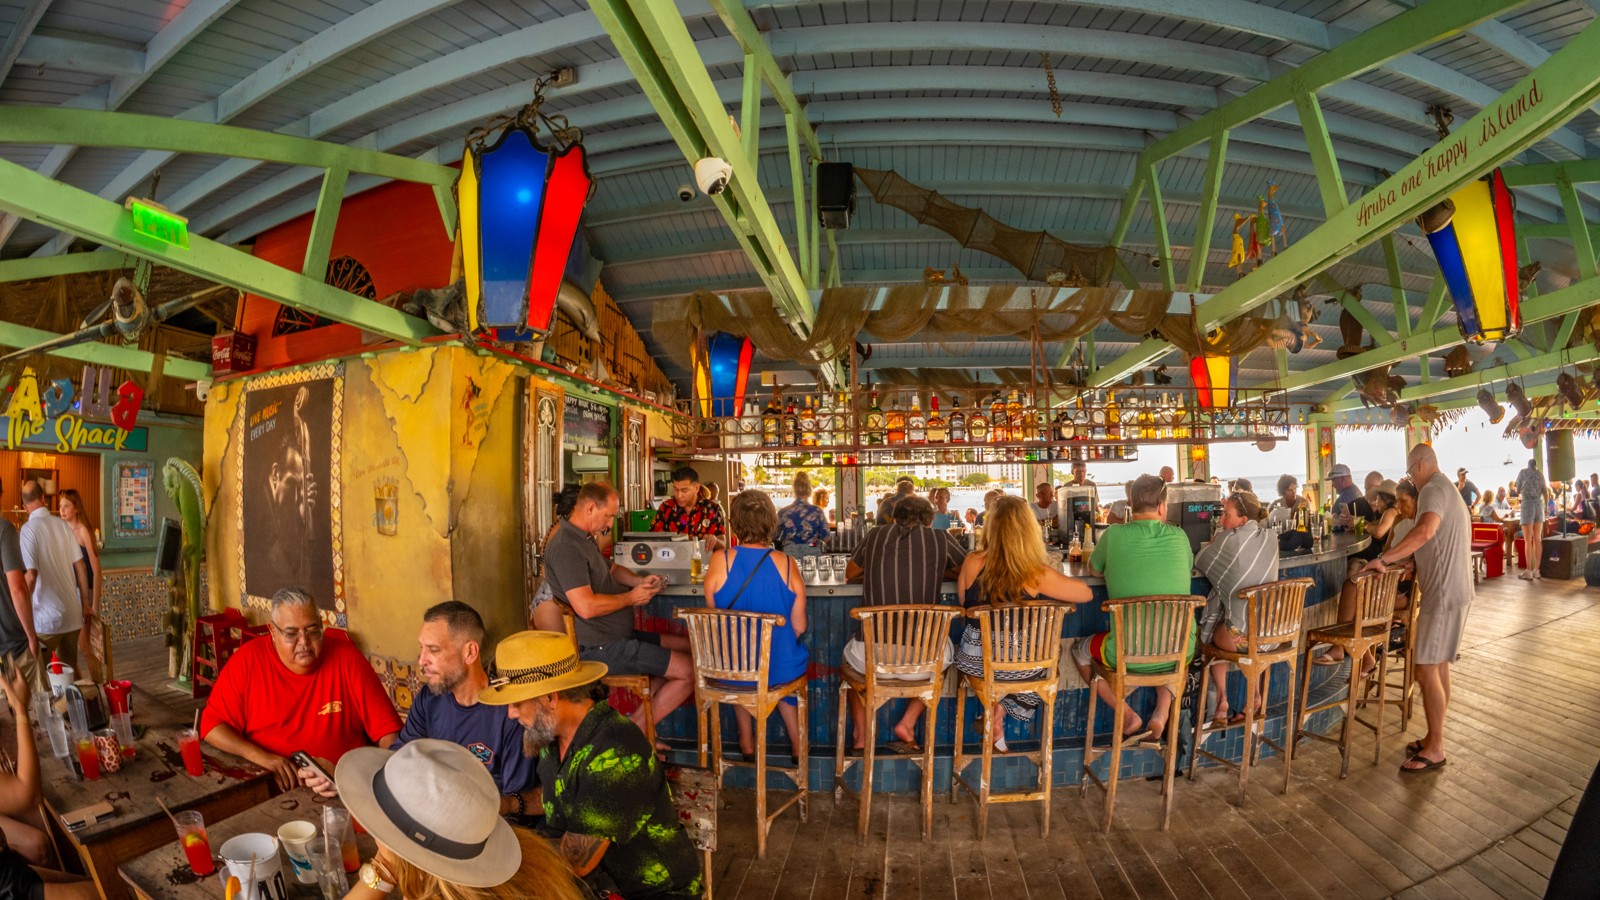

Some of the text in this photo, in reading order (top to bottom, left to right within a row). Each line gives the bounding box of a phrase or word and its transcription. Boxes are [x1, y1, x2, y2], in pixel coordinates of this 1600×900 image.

[1357, 78, 1543, 227] Aruba one happy island
[1, 413, 129, 453] The Shack
[250, 411, 260, 427] LIVE
[250, 418, 277, 441] EVERY DAY
